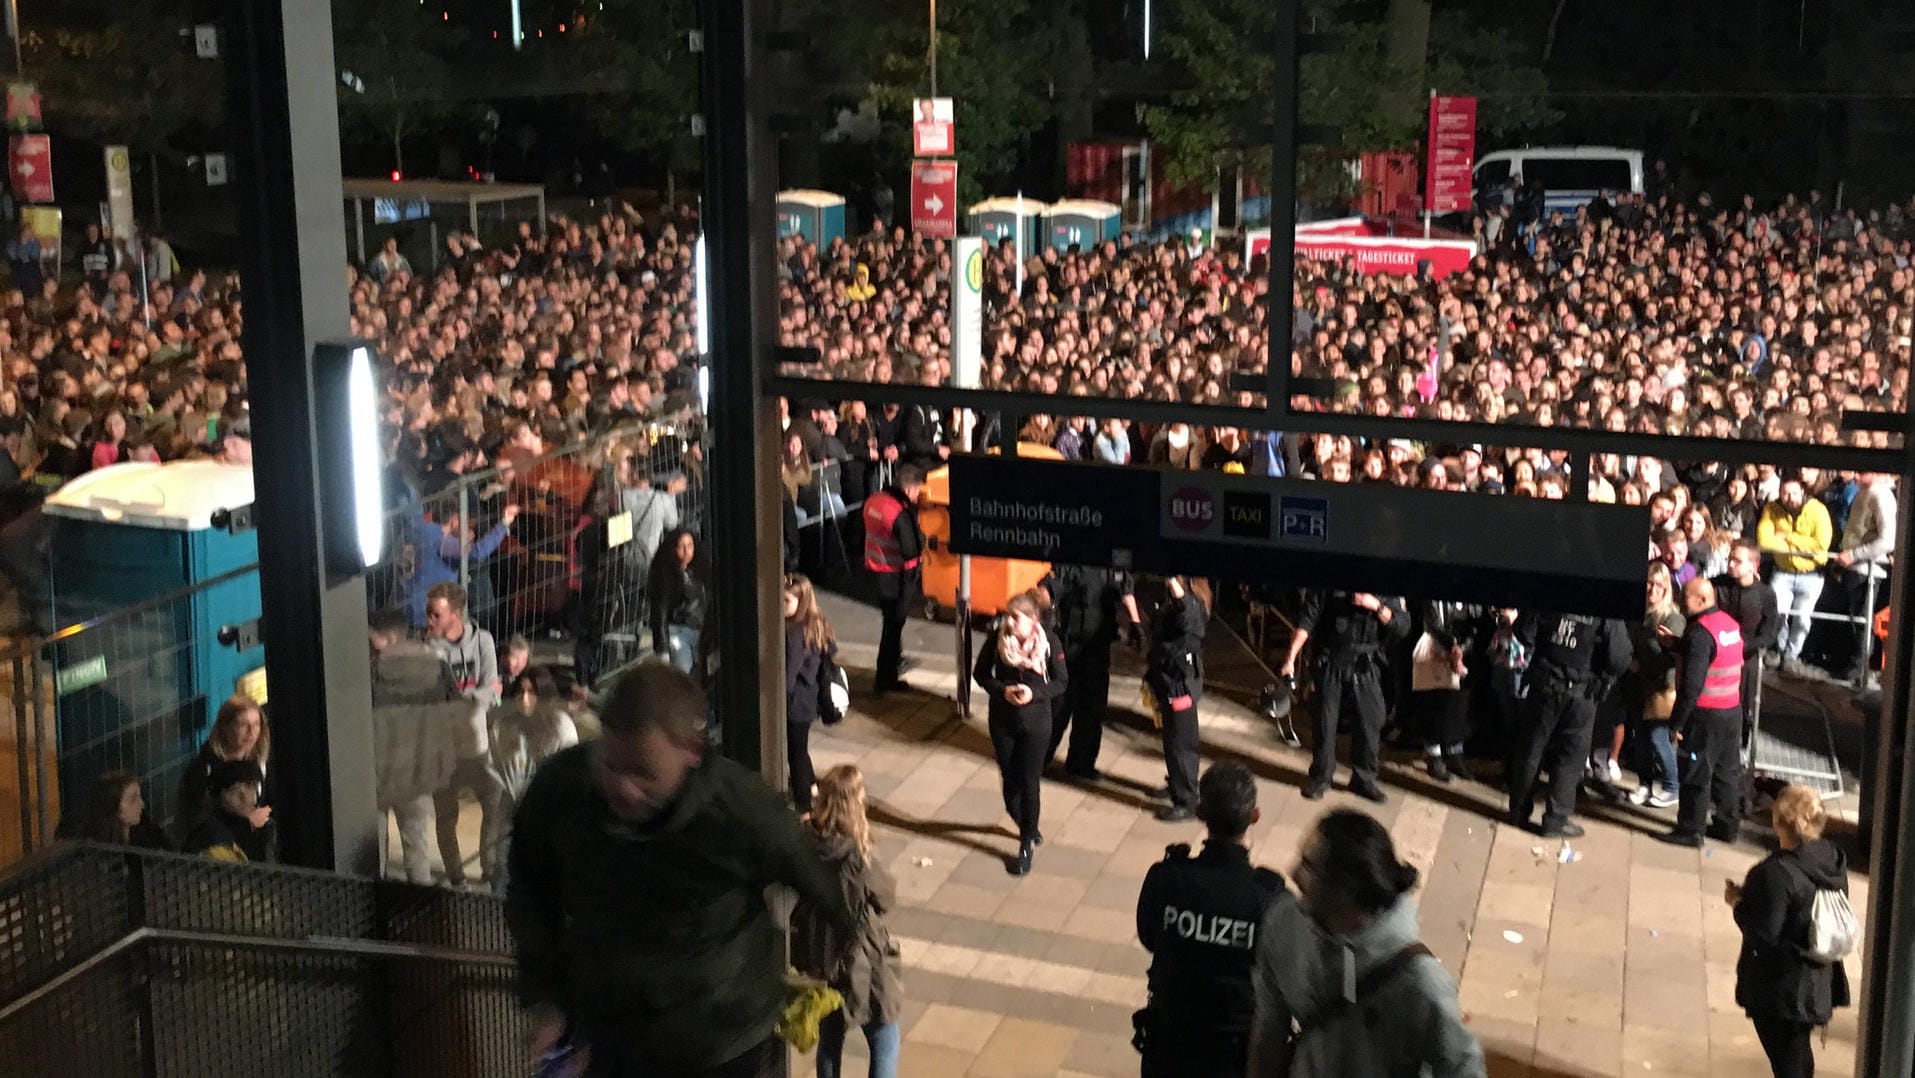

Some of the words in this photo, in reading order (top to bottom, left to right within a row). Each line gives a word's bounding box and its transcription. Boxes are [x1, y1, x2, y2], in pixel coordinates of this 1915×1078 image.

[1357, 250, 1415, 265] TAGESTICKET
[970, 497, 1102, 528] Bahnhofstraße
[1172, 498, 1213, 520] BUS
[1231, 506, 1262, 523] TAXI
[970, 521, 1061, 548] Rennbahn
[1163, 904, 1256, 950] POLIZEI
